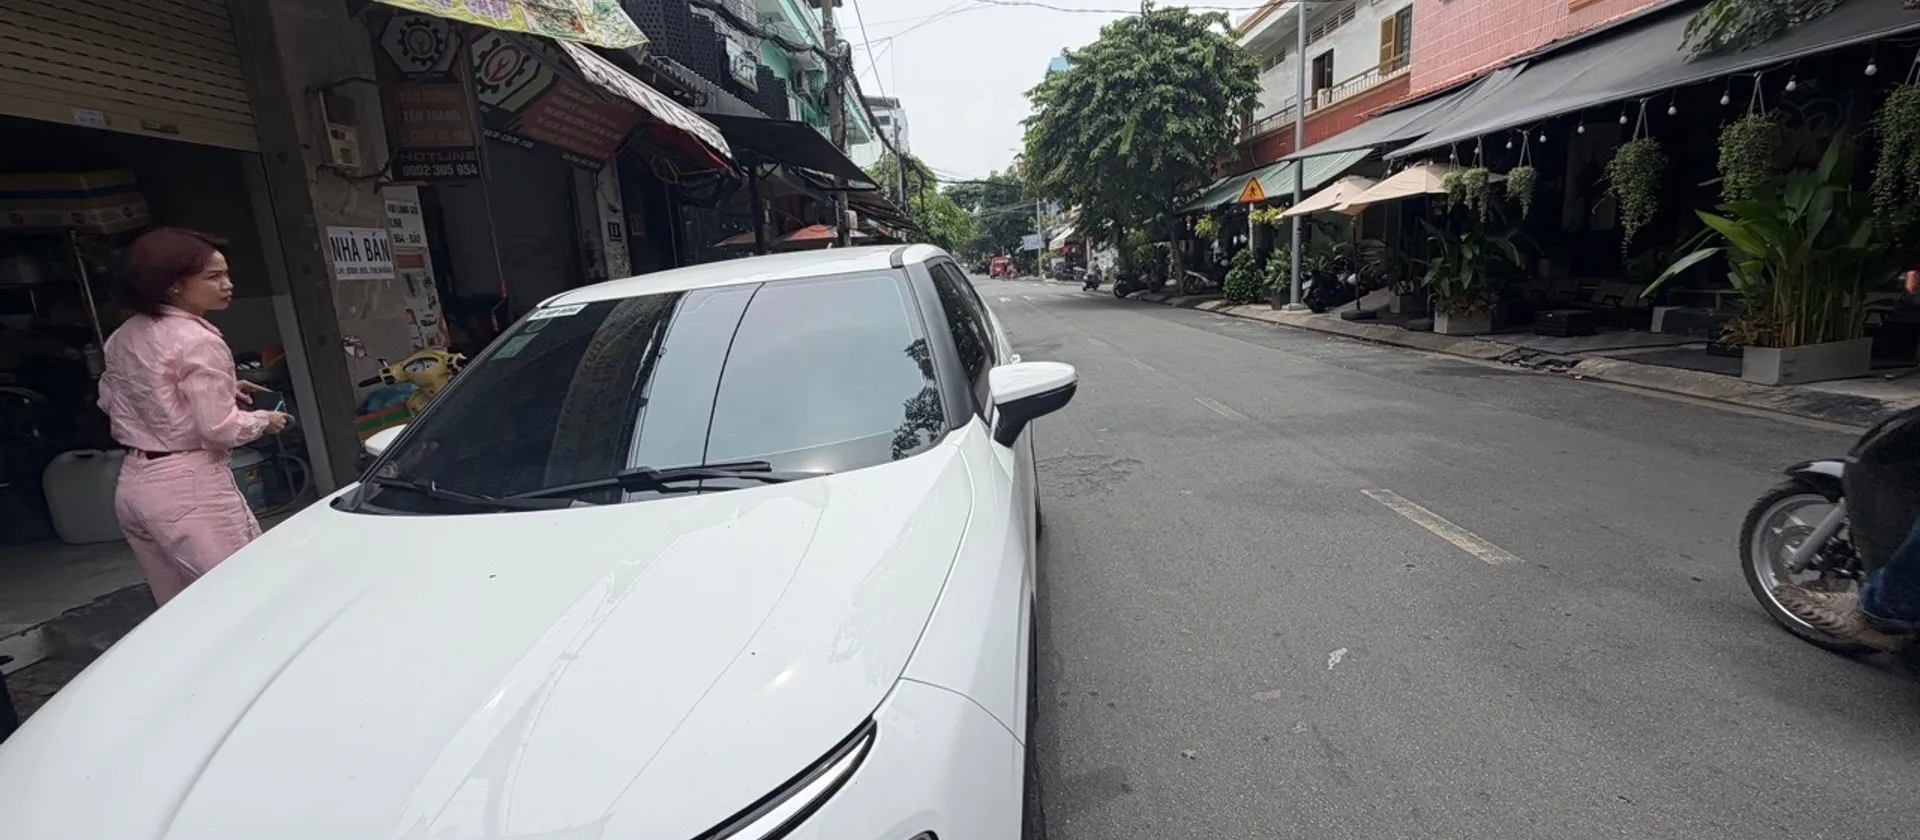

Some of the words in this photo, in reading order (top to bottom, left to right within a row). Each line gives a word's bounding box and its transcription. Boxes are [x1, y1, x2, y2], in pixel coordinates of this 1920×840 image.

[400, 151, 477, 162] HOTLINE
[330, 230, 362, 262] NHÀ
[363, 231, 392, 262] BÁN
